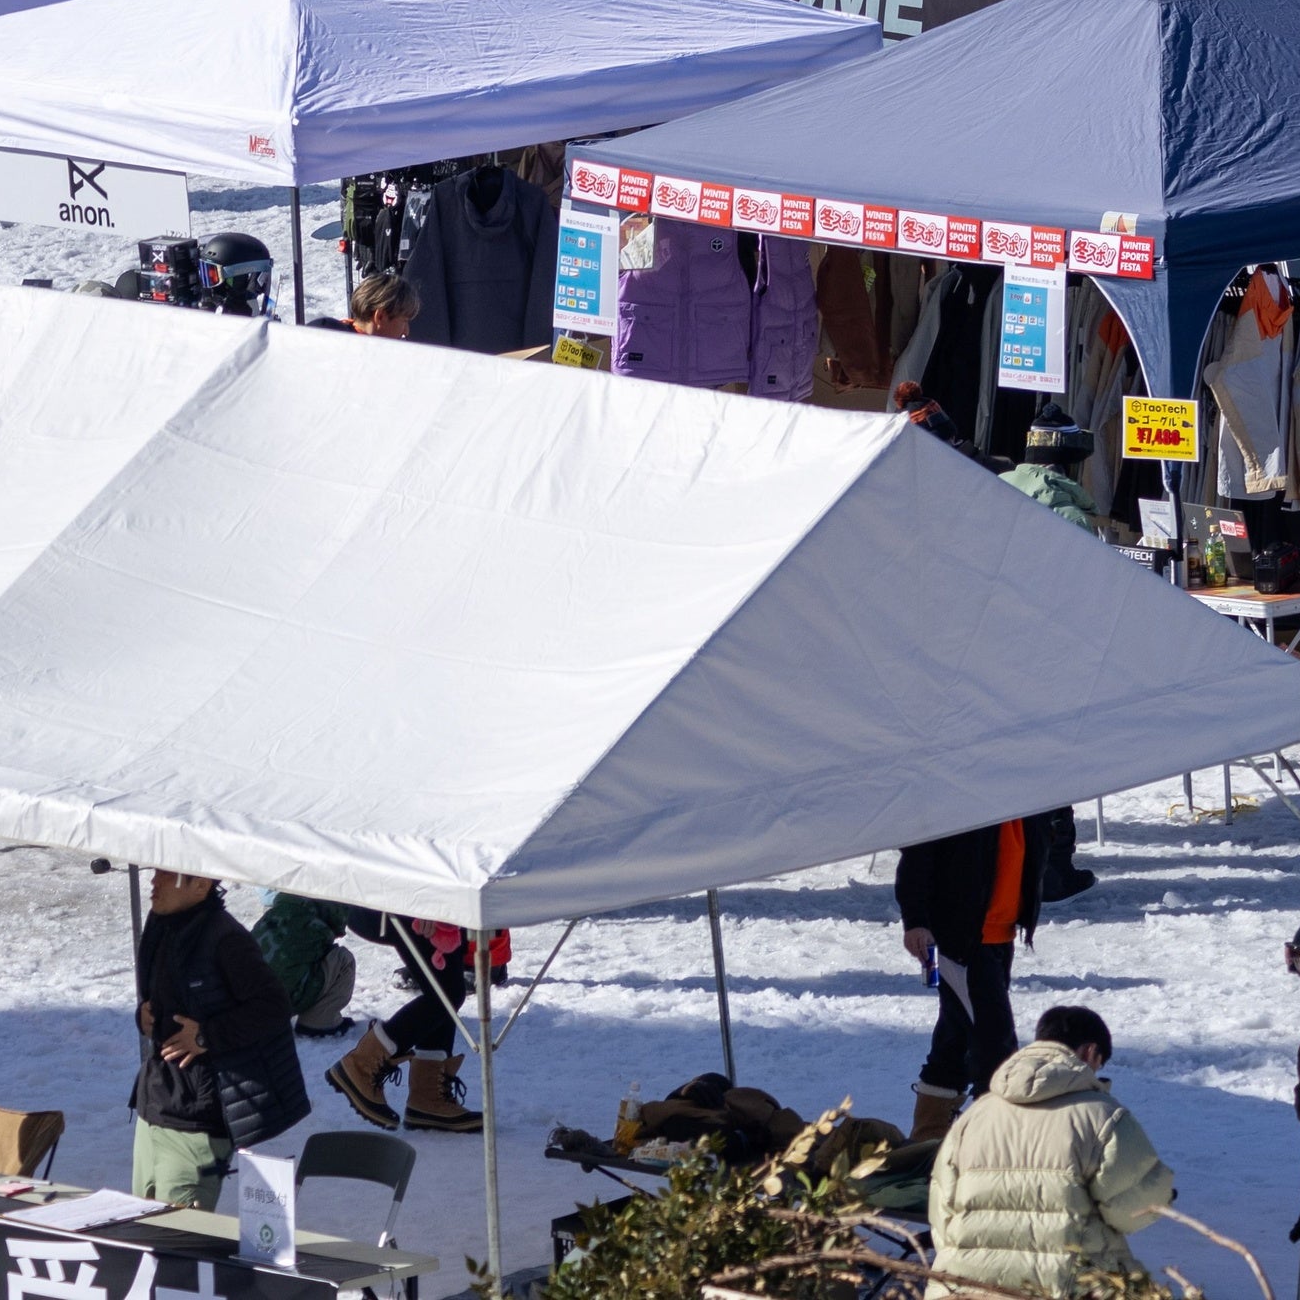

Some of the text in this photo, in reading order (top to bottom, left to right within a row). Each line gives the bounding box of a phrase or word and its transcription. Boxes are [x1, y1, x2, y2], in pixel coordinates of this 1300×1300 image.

[621, 174, 649, 187] WINTER
[620, 184, 647, 197] SPORTS
[703, 188, 730, 200] WINTER
[619, 194, 639, 206] FESTA
[702, 198, 728, 211] SPORTS
[783, 198, 810, 211] WINTER
[58, 202, 115, 228] anon.
[700, 208, 720, 220] FESTA
[782, 209, 810, 221] SPORTS
[865, 210, 893, 221] WINTER
[782, 220, 802, 230] FESTA
[865, 221, 892, 233] SPORTS
[949, 221, 977, 233] WINTER
[865, 231, 885, 242] FESTA
[949, 232, 976, 244] SPORTS
[1033, 232, 1062, 244] WINTER
[949, 242, 969, 254] FESTA
[1033, 243, 1061, 254] SPORTS
[1122, 241, 1151, 252] WINTER
[1033, 252, 1054, 264] FESTA
[1121, 251, 1149, 263] SPORTS
[1120, 261, 1141, 273] FESTA
[568, 343, 594, 361] TaoTech
[1143, 403, 1187, 415] TaoTech
[243, 1186, 288, 1207] 事前受付
